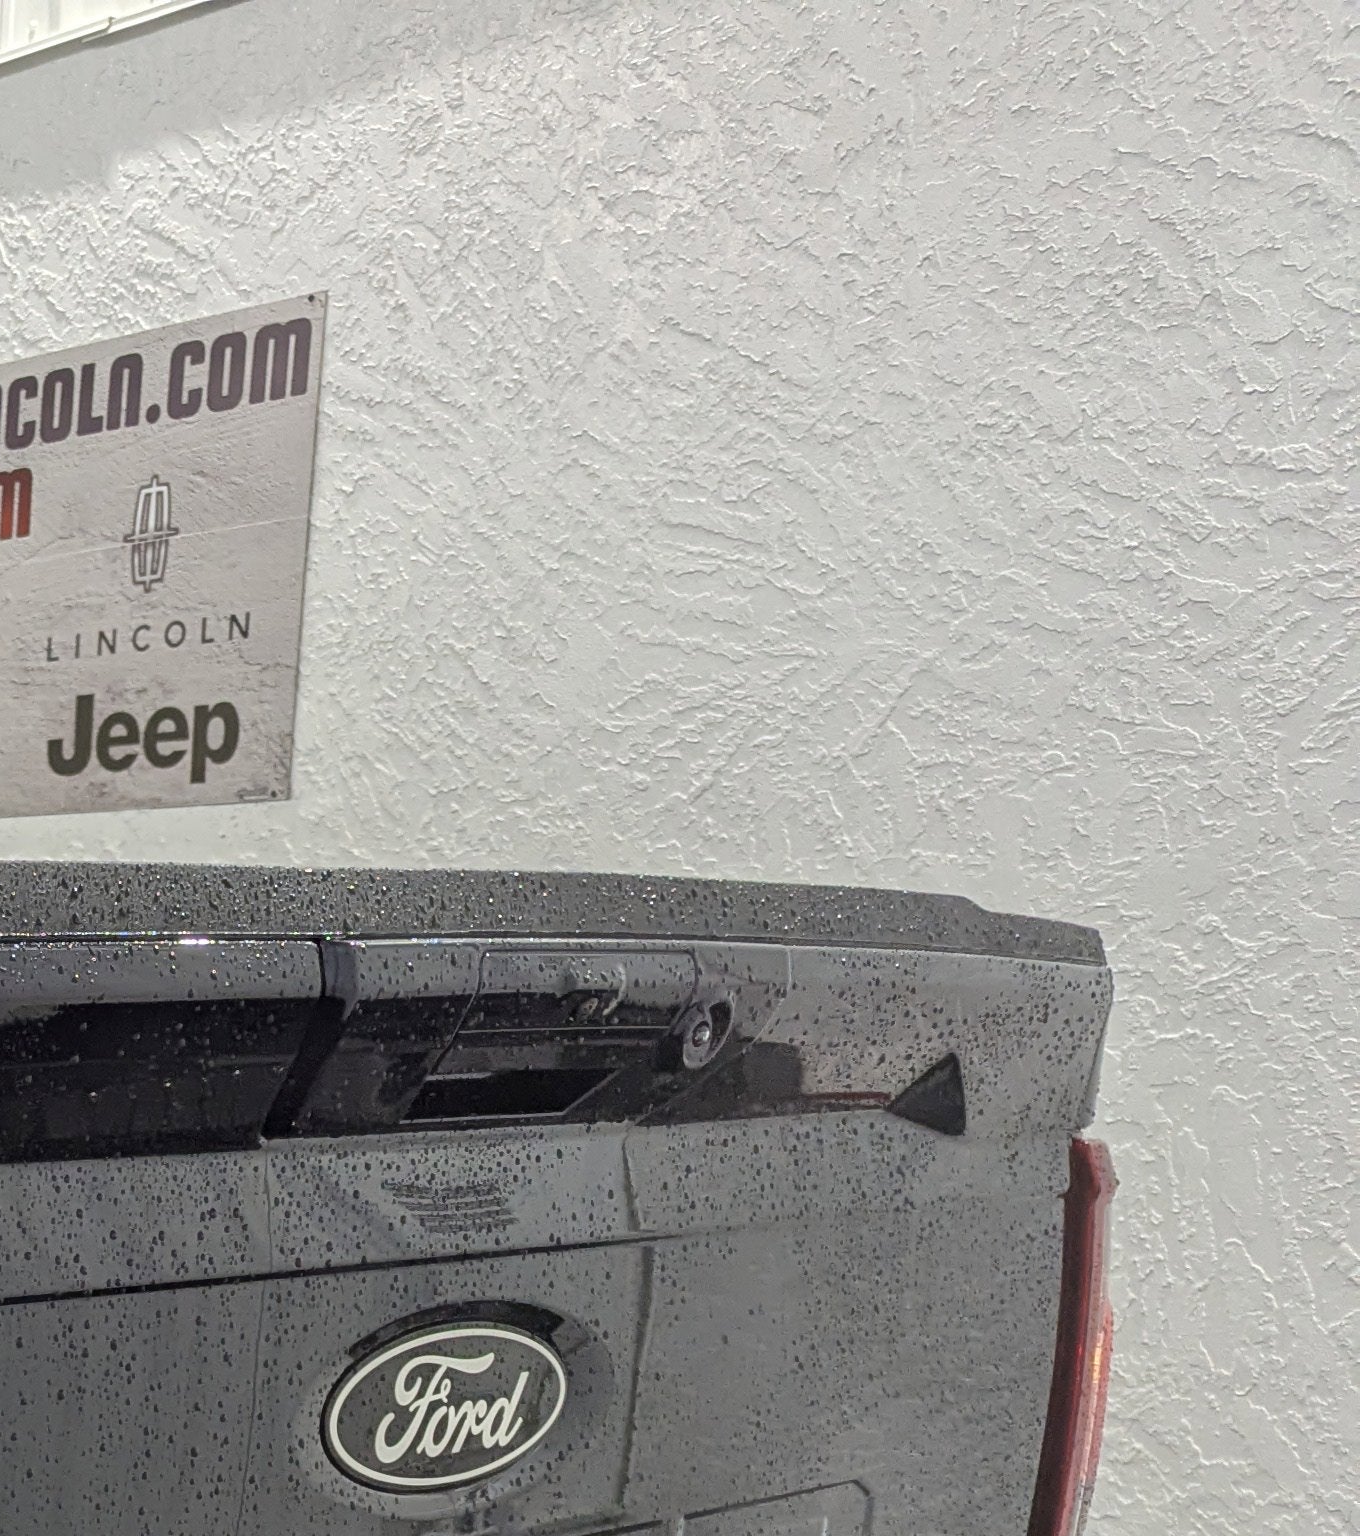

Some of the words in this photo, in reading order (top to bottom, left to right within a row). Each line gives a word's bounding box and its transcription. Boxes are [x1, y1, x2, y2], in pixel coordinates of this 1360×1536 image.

[46, 611, 251, 662] LINCOLN
[47, 693, 240, 784] Jeep
[374, 1352, 529, 1464] Ford
